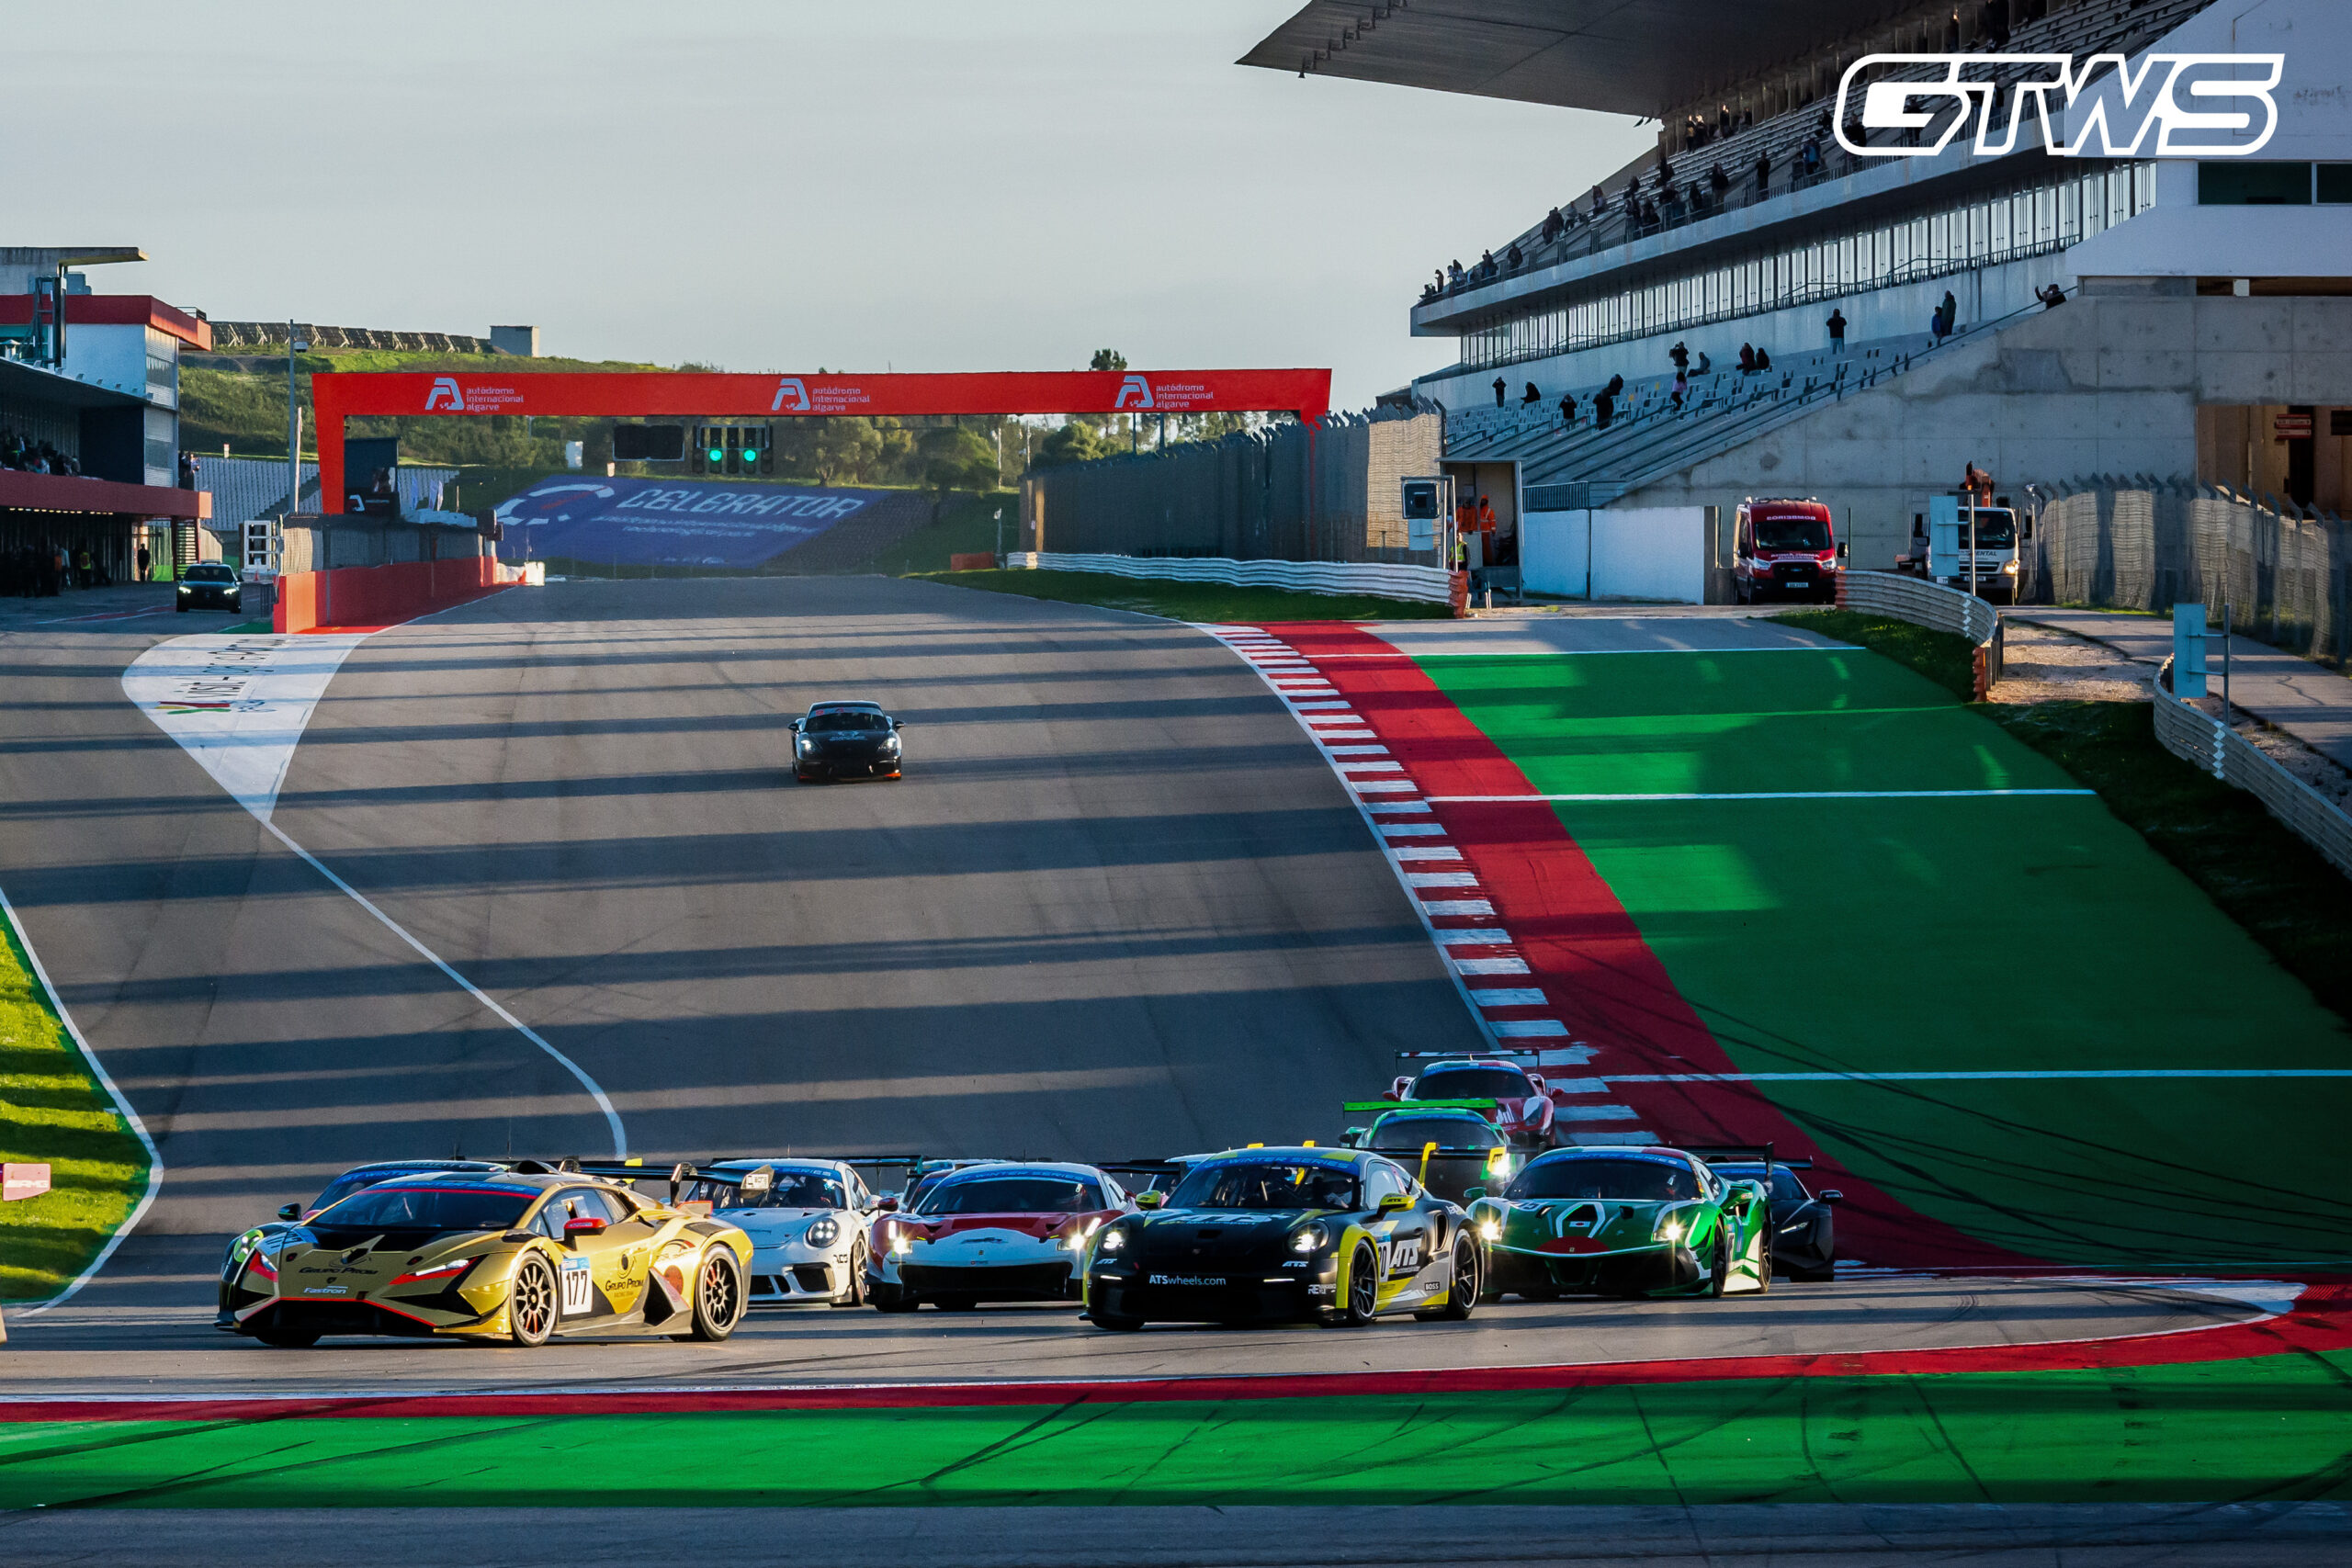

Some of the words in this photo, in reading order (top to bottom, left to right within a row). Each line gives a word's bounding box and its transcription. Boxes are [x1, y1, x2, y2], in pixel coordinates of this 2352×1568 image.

[466, 403, 500, 412] algarve
[812, 403, 845, 412] algarve
[1156, 400, 1190, 409] algarve
[1228, 1156, 1288, 1165] WINTER
[1290, 1157, 1353, 1169] SERIES
[1032, 1171, 1084, 1181] SERIES
[1389, 1238, 1422, 1268] ATS
[1282, 1259, 1309, 1268] ATS
[1148, 1274, 1227, 1286] ATSwheels.com
[566, 1270, 587, 1305] 177
[1425, 1282, 1439, 1291] BOSS
